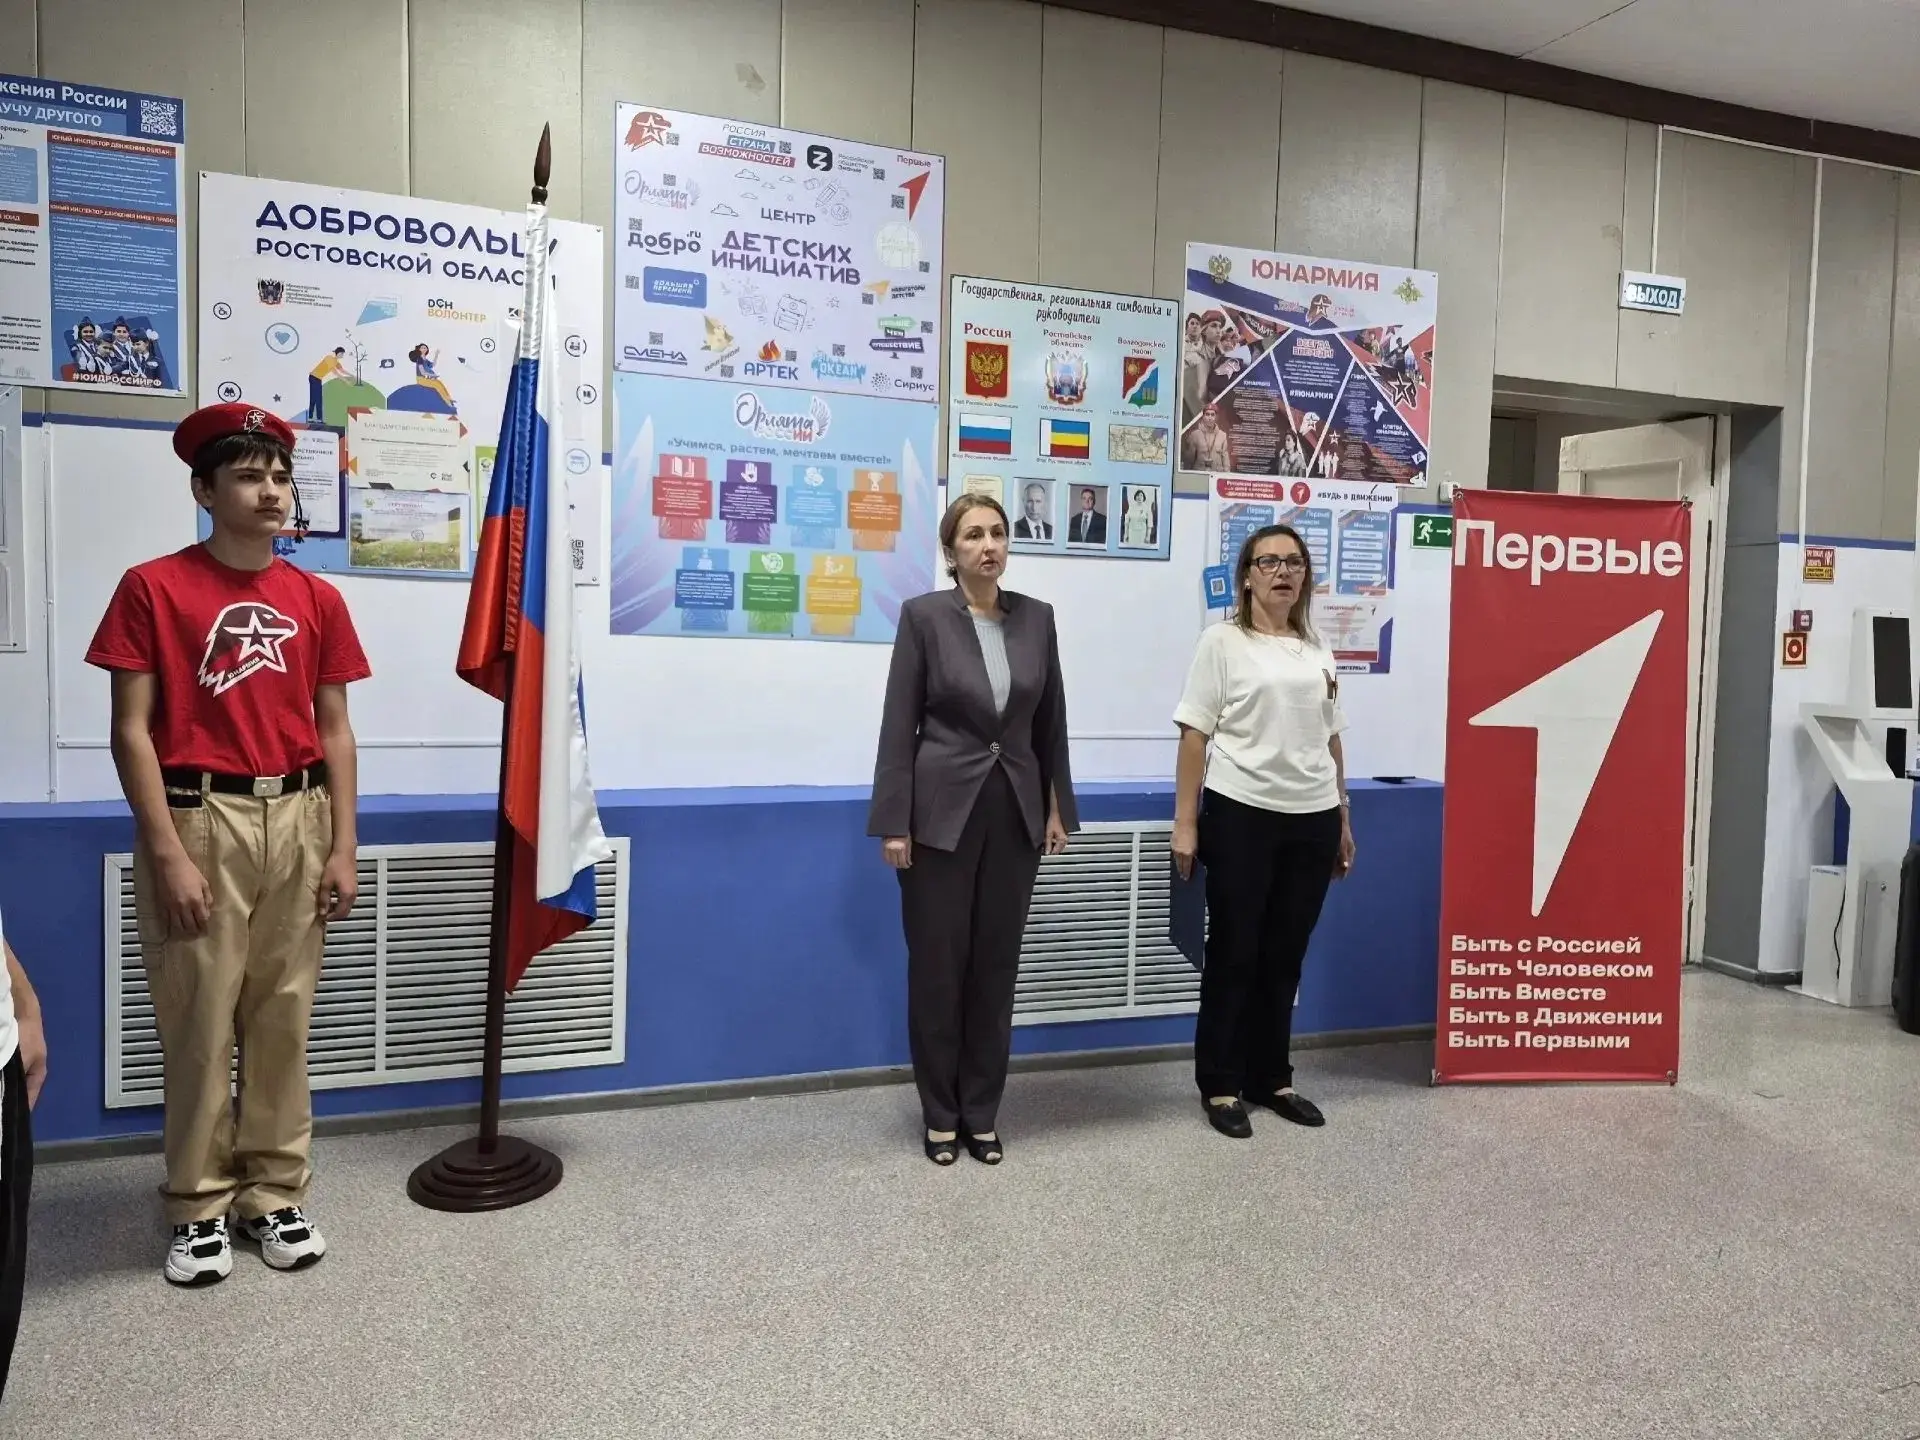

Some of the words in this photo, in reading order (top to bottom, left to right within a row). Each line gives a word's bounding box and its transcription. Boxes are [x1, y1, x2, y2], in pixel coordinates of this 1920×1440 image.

[62, 86, 127, 109] России
[0, 102, 31, 117] УЧУ
[35, 107, 102, 127] ДРУГОГО
[723, 123, 766, 137] РОССИЯ
[52, 134, 73, 142] ЮНЫЙ
[74, 136, 110, 147] ИНСПЕКТОР
[111, 142, 146, 152] ДВИЖЕНИЯ
[729, 138, 772, 152] СТРАНА
[701, 143, 791, 167] ВОЗМОЖНОСТЕЙ
[896, 154, 932, 168] Первые
[624, 169, 689, 202] Орлята
[760, 206, 816, 225] ЦЕНТР
[256, 200, 558, 258] ДОБРОВОЛЬ
[721, 230, 851, 263] ДЕТСКИХ
[256, 237, 432, 274] РОСТОВСКОЙ
[442, 260, 557, 290] ОБЛАС
[711, 249, 861, 286] ИНИЦИАТИВ
[1251, 258, 1380, 292] ЮНАРМИЯ
[653, 285, 693, 295] ПЕРЕМЕНА
[960, 279, 1046, 304] Государственная,
[1049, 294, 1112, 310] региональная
[1116, 301, 1162, 316] символика
[1166, 308, 1172, 316] и
[1626, 284, 1678, 308] ВЫХОД
[427, 308, 487, 323] ВОЛОНТЕР
[1035, 308, 1101, 326] руководители
[964, 321, 1012, 339] Россия
[1043, 328, 1093, 341] Ростовская
[623, 346, 688, 360] СМЕНА
[744, 361, 799, 381] АРТЕК
[819, 361, 859, 376] ОКЕАН
[72, 373, 162, 388] #ЮИДРОССИИРФ
[894, 379, 936, 393] Сириус
[736, 392, 814, 431] Орлята
[667, 437, 726, 453] «Учимся,
[730, 443, 779, 457] растем,
[783, 448, 837, 461] мечтаем
[840, 452, 892, 465] вместе!»
[1350, 493, 1393, 503] ДВИЖЕНИИ
[1454, 518, 1684, 586] Первые
[227, 656, 260, 679] ЮНАРМИЯ
[1451, 934, 1513, 953] Быть
[1517, 939, 1532, 953] с
[1537, 936, 1641, 953] Россией
[1450, 958, 1512, 976] Быть
[1516, 959, 1653, 978] Человеком
[1449, 982, 1511, 1000] Быть
[1516, 983, 1607, 1001] Вместе
[1448, 1006, 1511, 1024] Быть
[1515, 1011, 1530, 1024] в
[1533, 1007, 1663, 1027] Движении
[1448, 1031, 1510, 1048] Быть
[1514, 1031, 1630, 1051] Первыми
